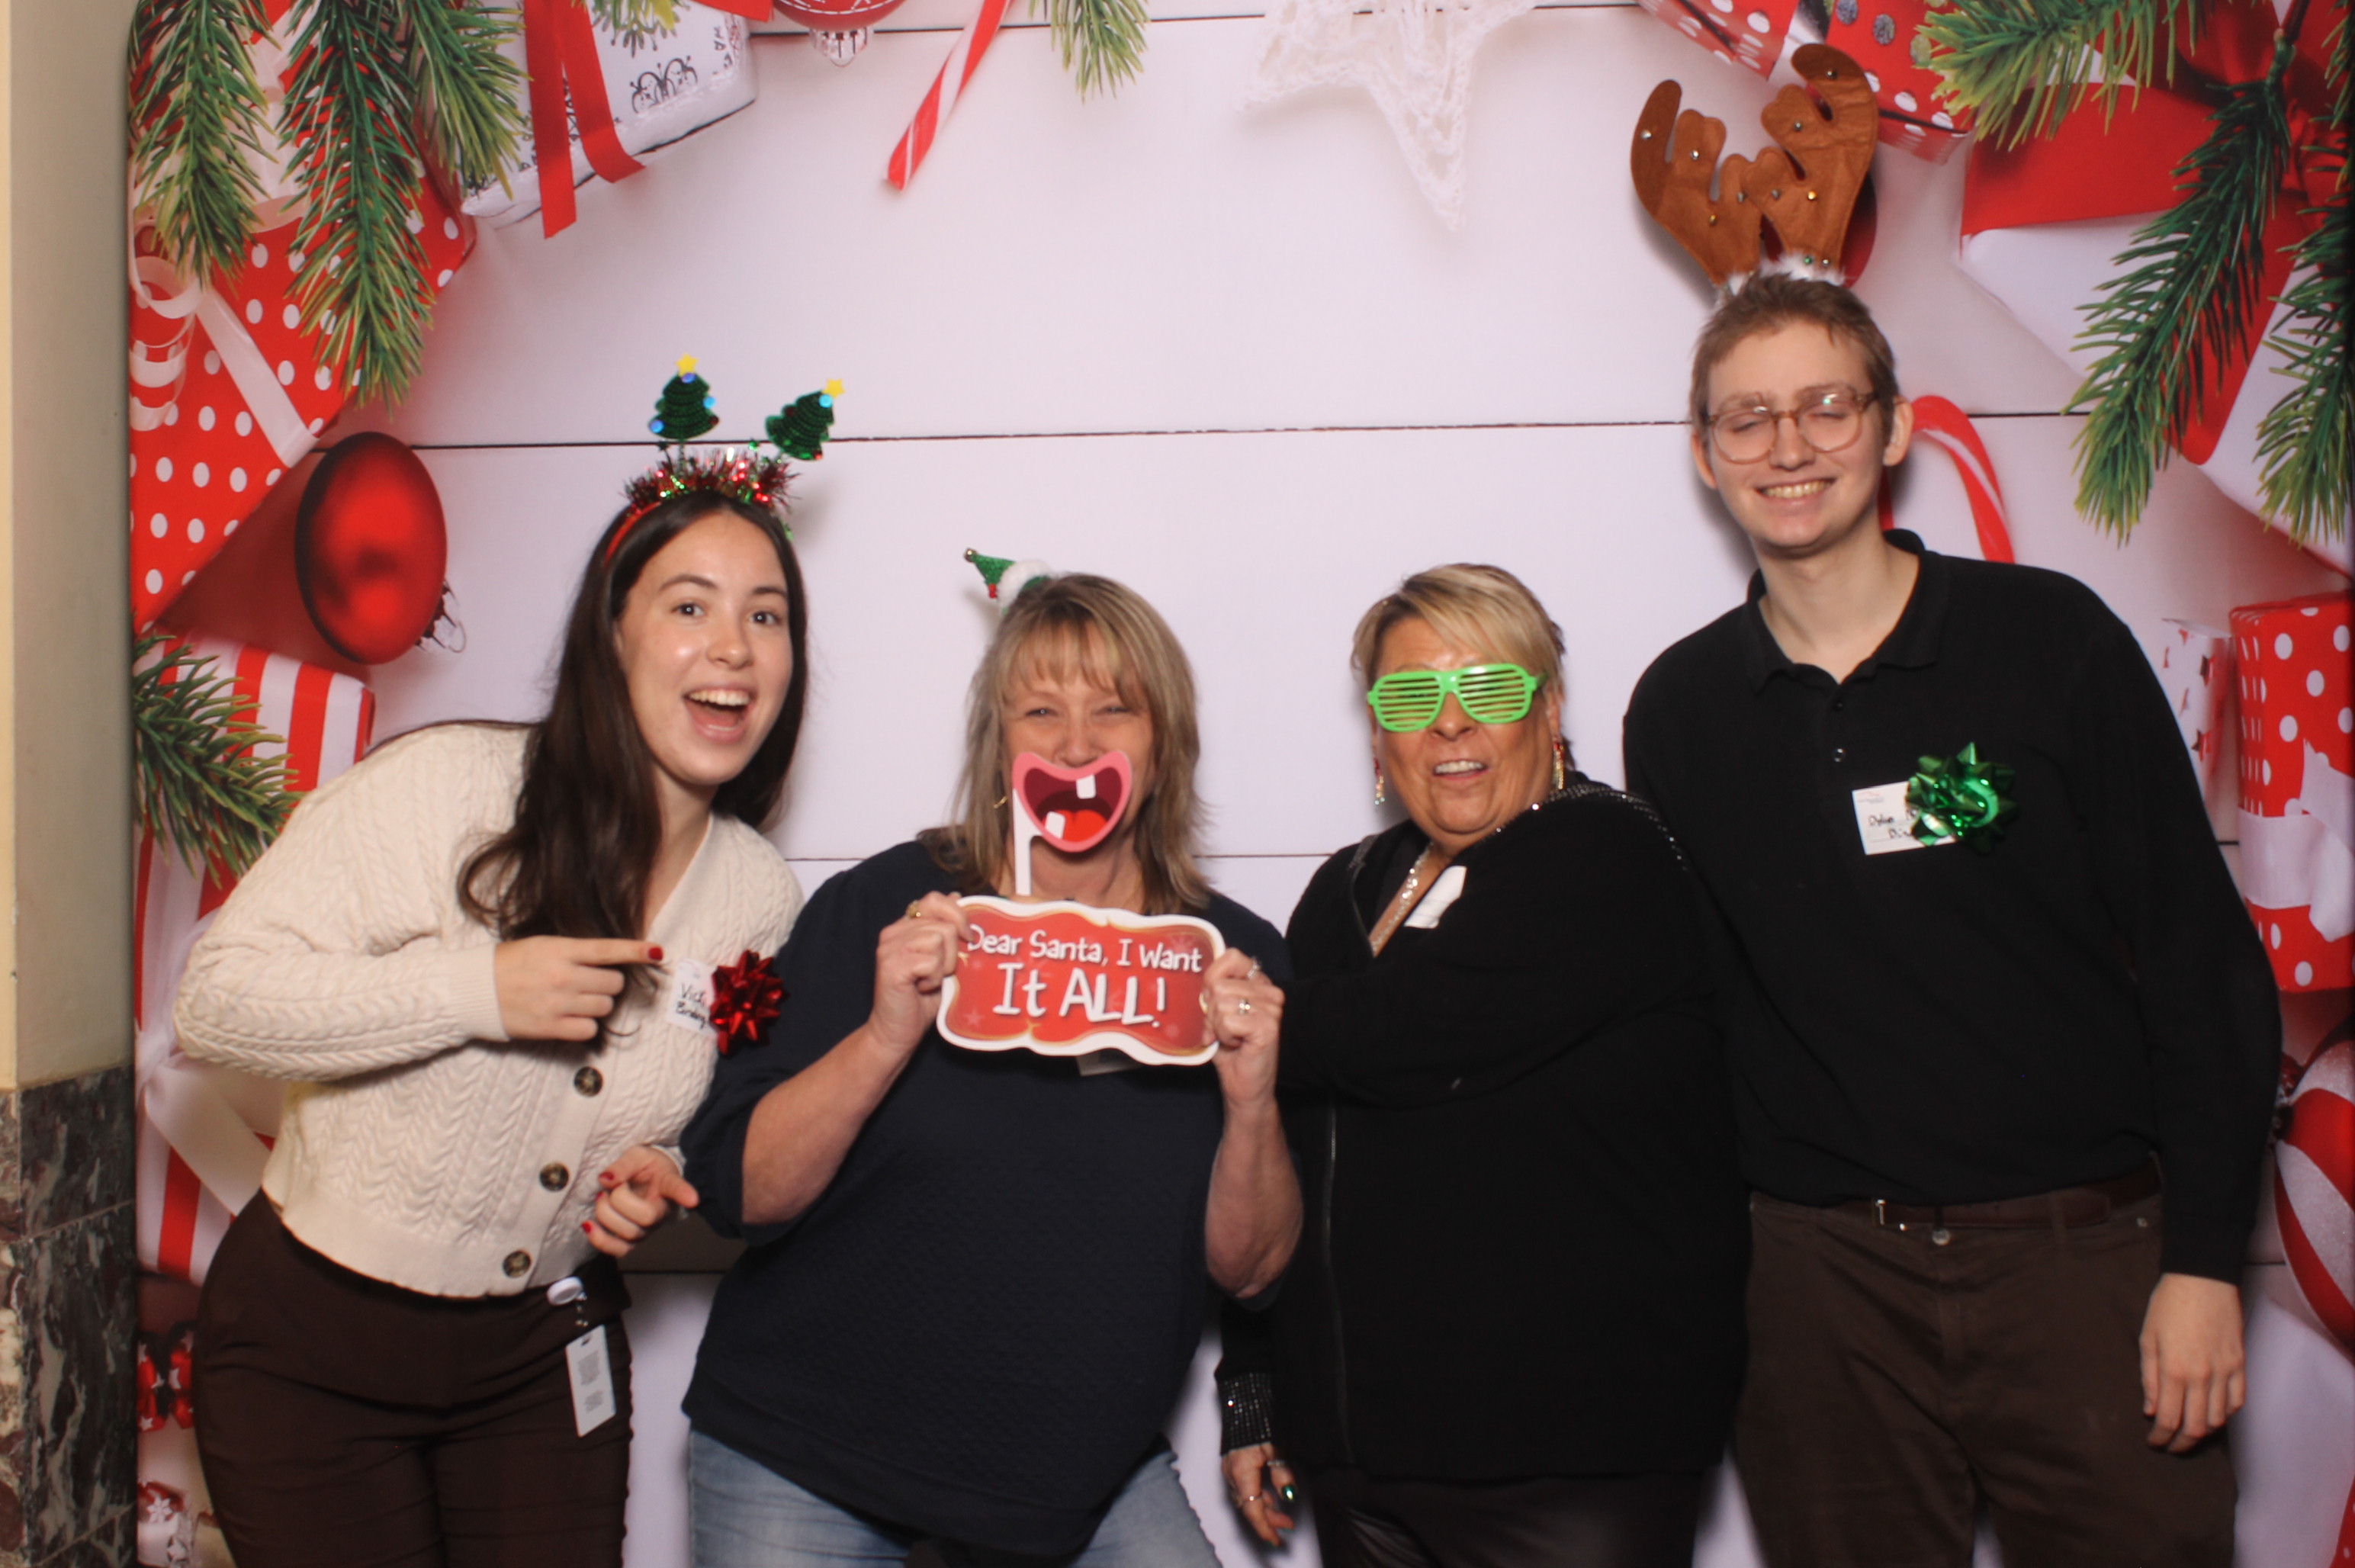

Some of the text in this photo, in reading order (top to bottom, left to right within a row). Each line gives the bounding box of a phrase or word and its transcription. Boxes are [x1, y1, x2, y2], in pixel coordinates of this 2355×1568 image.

[967, 923, 1203, 973] Dear Santa, I Want
[992, 962, 1166, 1029] It ALL!
